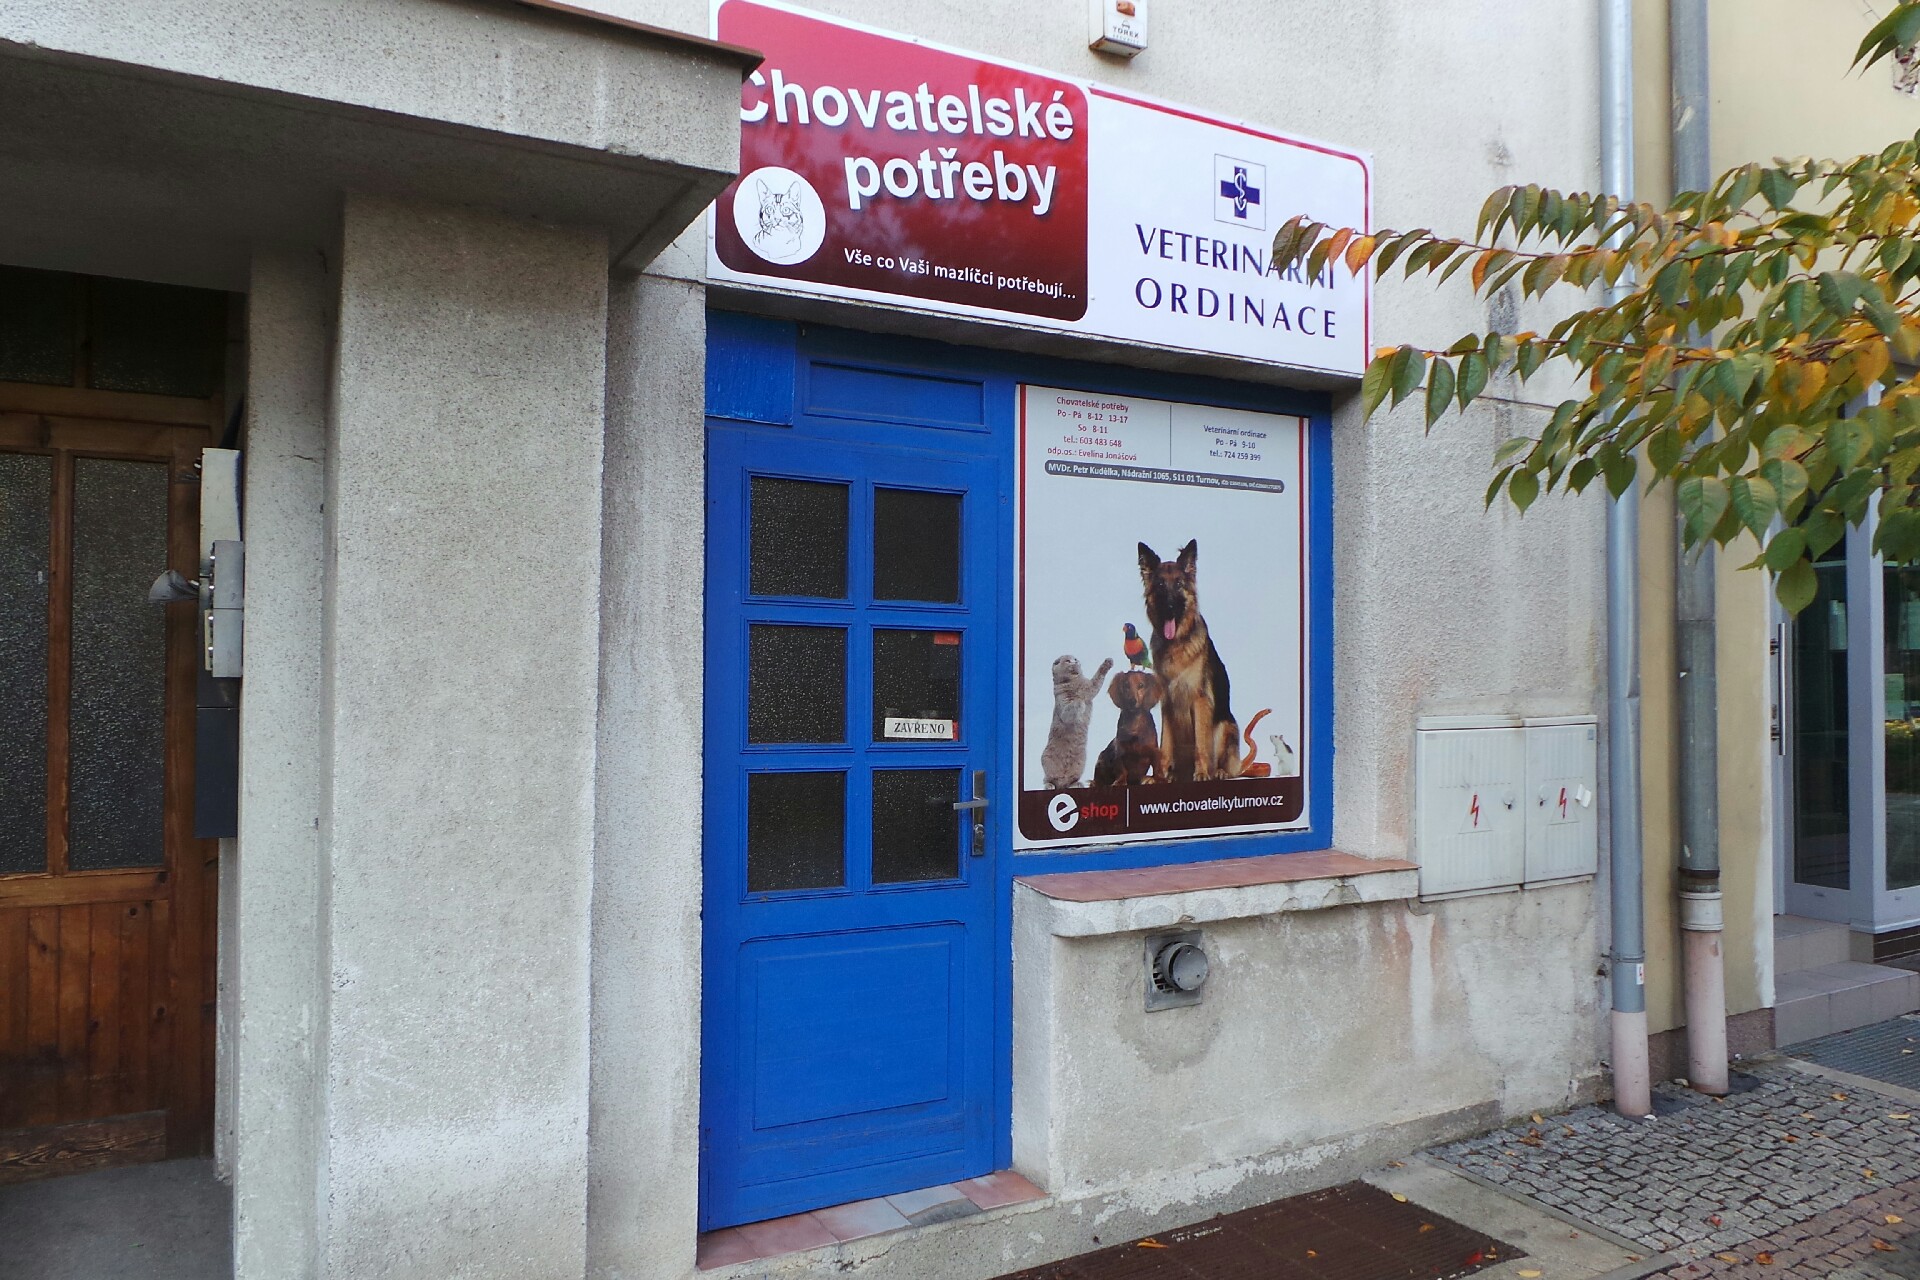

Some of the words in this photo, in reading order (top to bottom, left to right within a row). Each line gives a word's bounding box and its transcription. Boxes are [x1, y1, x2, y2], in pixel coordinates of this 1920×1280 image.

[740, 69, 1074, 141] Chovatelské
[844, 147, 1057, 216] potřeby
[844, 247, 872, 266] Vše
[876, 256, 895, 269] co
[898, 256, 930, 276] Vaši
[934, 264, 994, 286] mazlíčci
[997, 274, 1076, 299] potřebují...
[1135, 277, 1336, 339] ORDINACE
[1056, 396, 1100, 409] Chovatelské
[1101, 402, 1129, 413] potřeby
[1057, 409, 1067, 417] Po
[1073, 410, 1082, 419] Pá
[1087, 413, 1103, 421] 8-12
[1109, 414, 1129, 424] 13-17
[1078, 424, 1087, 432] So
[1092, 425, 1108, 434] 8-11
[1203, 424, 1240, 436] Veterinární
[1240, 429, 1267, 439] ordinace
[1079, 436, 1093, 445] 603
[1094, 438, 1108, 446] 483
[1215, 438, 1224, 446] Po
[1224, 451, 1236, 459] 724
[1048, 463, 1072, 473] MVDr.
[1073, 465, 1088, 474] Petr
[1121, 468, 1152, 479] Nádražní
[1172, 473, 1185, 482] 511
[1186, 474, 1195, 483] 01
[1196, 475, 1220, 486] Turnov,
[893, 721, 945, 734] ZAVŘENO
[1048, 793, 1079, 832] e
[1081, 802, 1119, 820] shop
[1140, 795, 1284, 815] www.chovatelkyturnov.cz
